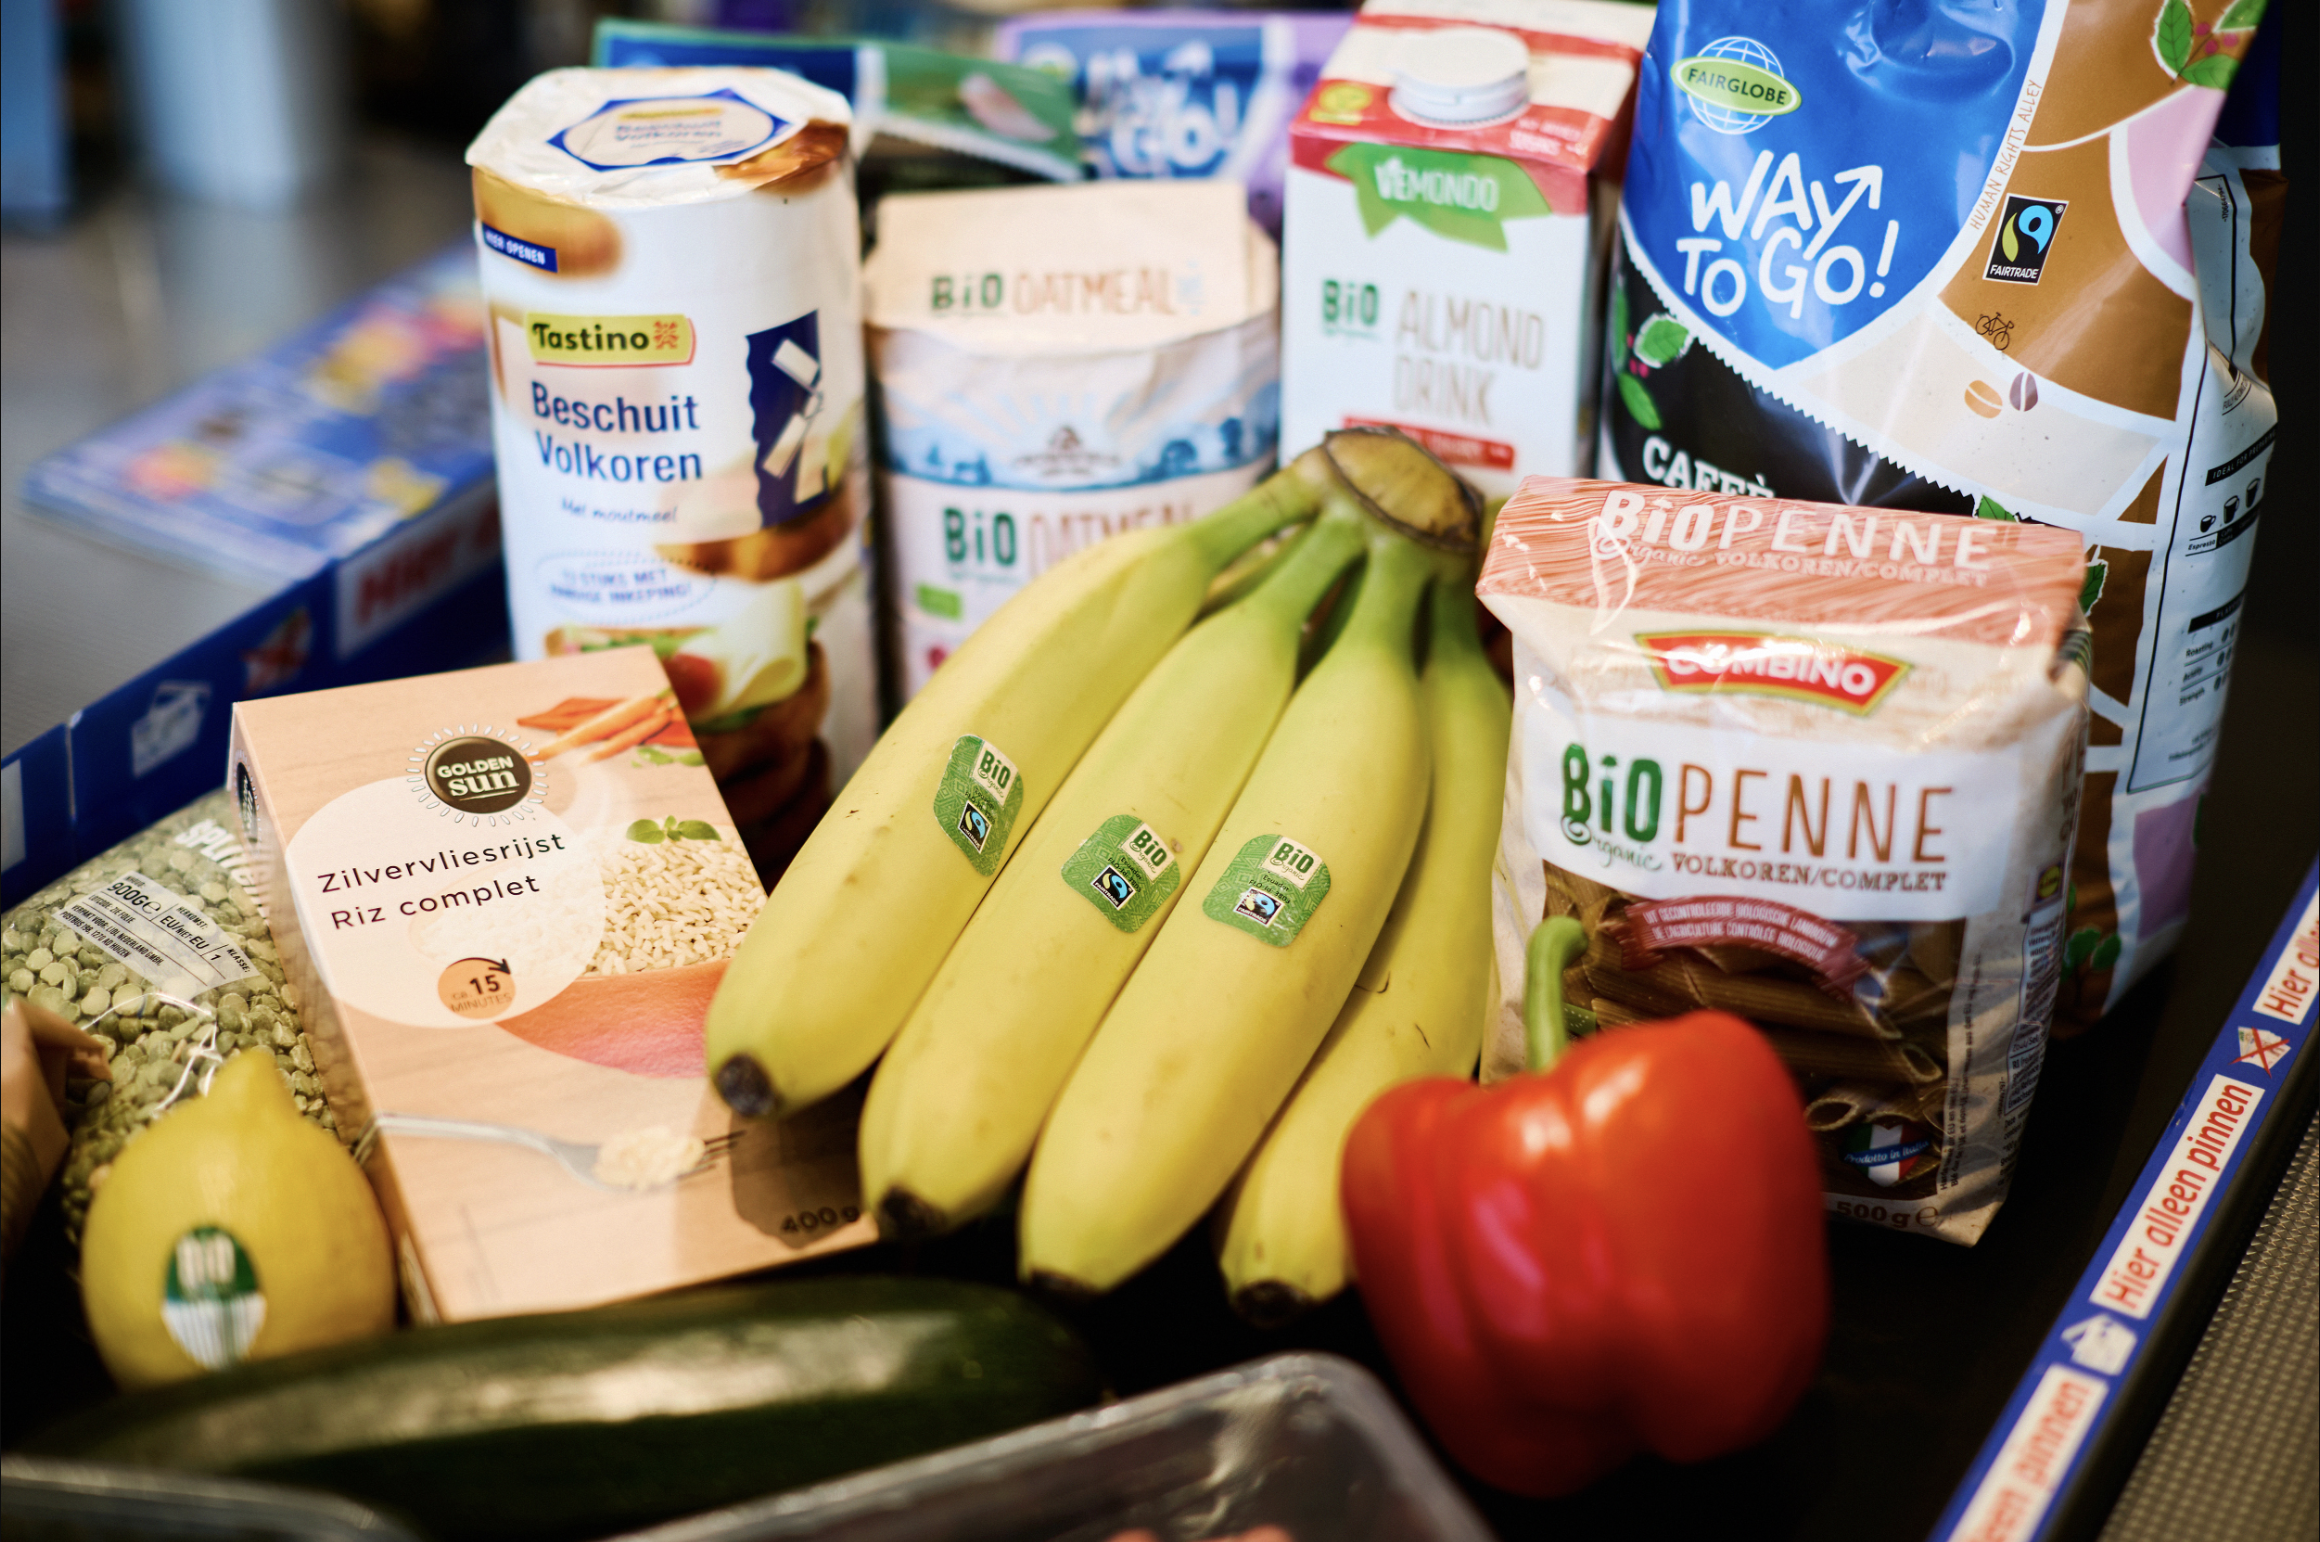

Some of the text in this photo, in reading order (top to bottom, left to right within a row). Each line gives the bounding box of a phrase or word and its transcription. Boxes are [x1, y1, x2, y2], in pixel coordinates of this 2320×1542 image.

[1688, 68, 1787, 105] FAIRGLOBE
[1970, 79, 2043, 230] HUMAN RIGHTS ALLEY
[1691, 150, 1883, 261] WAY
[507, 241, 546, 265] OPENEN
[1676, 219, 1899, 319] TO GO!
[1989, 264, 2039, 279] FAIRTRADE
[1013, 267, 1177, 316] OATMEAL
[532, 322, 650, 350] Tastino
[1397, 290, 1545, 370] ALMOND
[531, 379, 700, 433] Beschuit
[1394, 354, 1497, 427] DRINK
[535, 430, 702, 482] Volkoren
[1719, 505, 1998, 571] PENNE
[1715, 551, 1988, 587] VOLKOREN/COMPLET
[437, 755, 515, 778] GOLDEN
[448, 770, 520, 797] sun
[1674, 763, 1953, 864] PENNE
[318, 833, 566, 894] Zilvervliesrijst
[1121, 857, 1142, 880] Ecuador
[1673, 852, 1948, 892] VOLKOREN/COMPLET
[1094, 882, 1119, 906] FAIRTRADE
[1263, 874, 1290, 891] Ecuador
[60, 911, 86, 927] POSTBUS
[118, 913, 136, 924] FOLIE
[176, 907, 209, 930] HERKOMST:
[332, 876, 540, 930] Riz complet
[1659, 902, 1734, 921] GECONTROLEERDE
[1736, 903, 1791, 926] BIOLOGISCHE
[71, 904, 95, 920] VERPAKT
[106, 926, 121, 936] LIDL
[117, 934, 149, 955] NEDERLAND
[1777, 930, 1828, 962] BIOLOGIQUE
[226, 949, 251, 973] KLASSE:
[450, 992, 512, 1013] MINUTES
[470, 975, 501, 996] 15
[2263, 969, 2312, 1018] Hier
[1844, 1140, 1930, 1164] Prodotto in Italia
[2102, 1083, 2253, 1310] Hier alleen pinnen
[2013, 1381, 2091, 1490] pinnen
